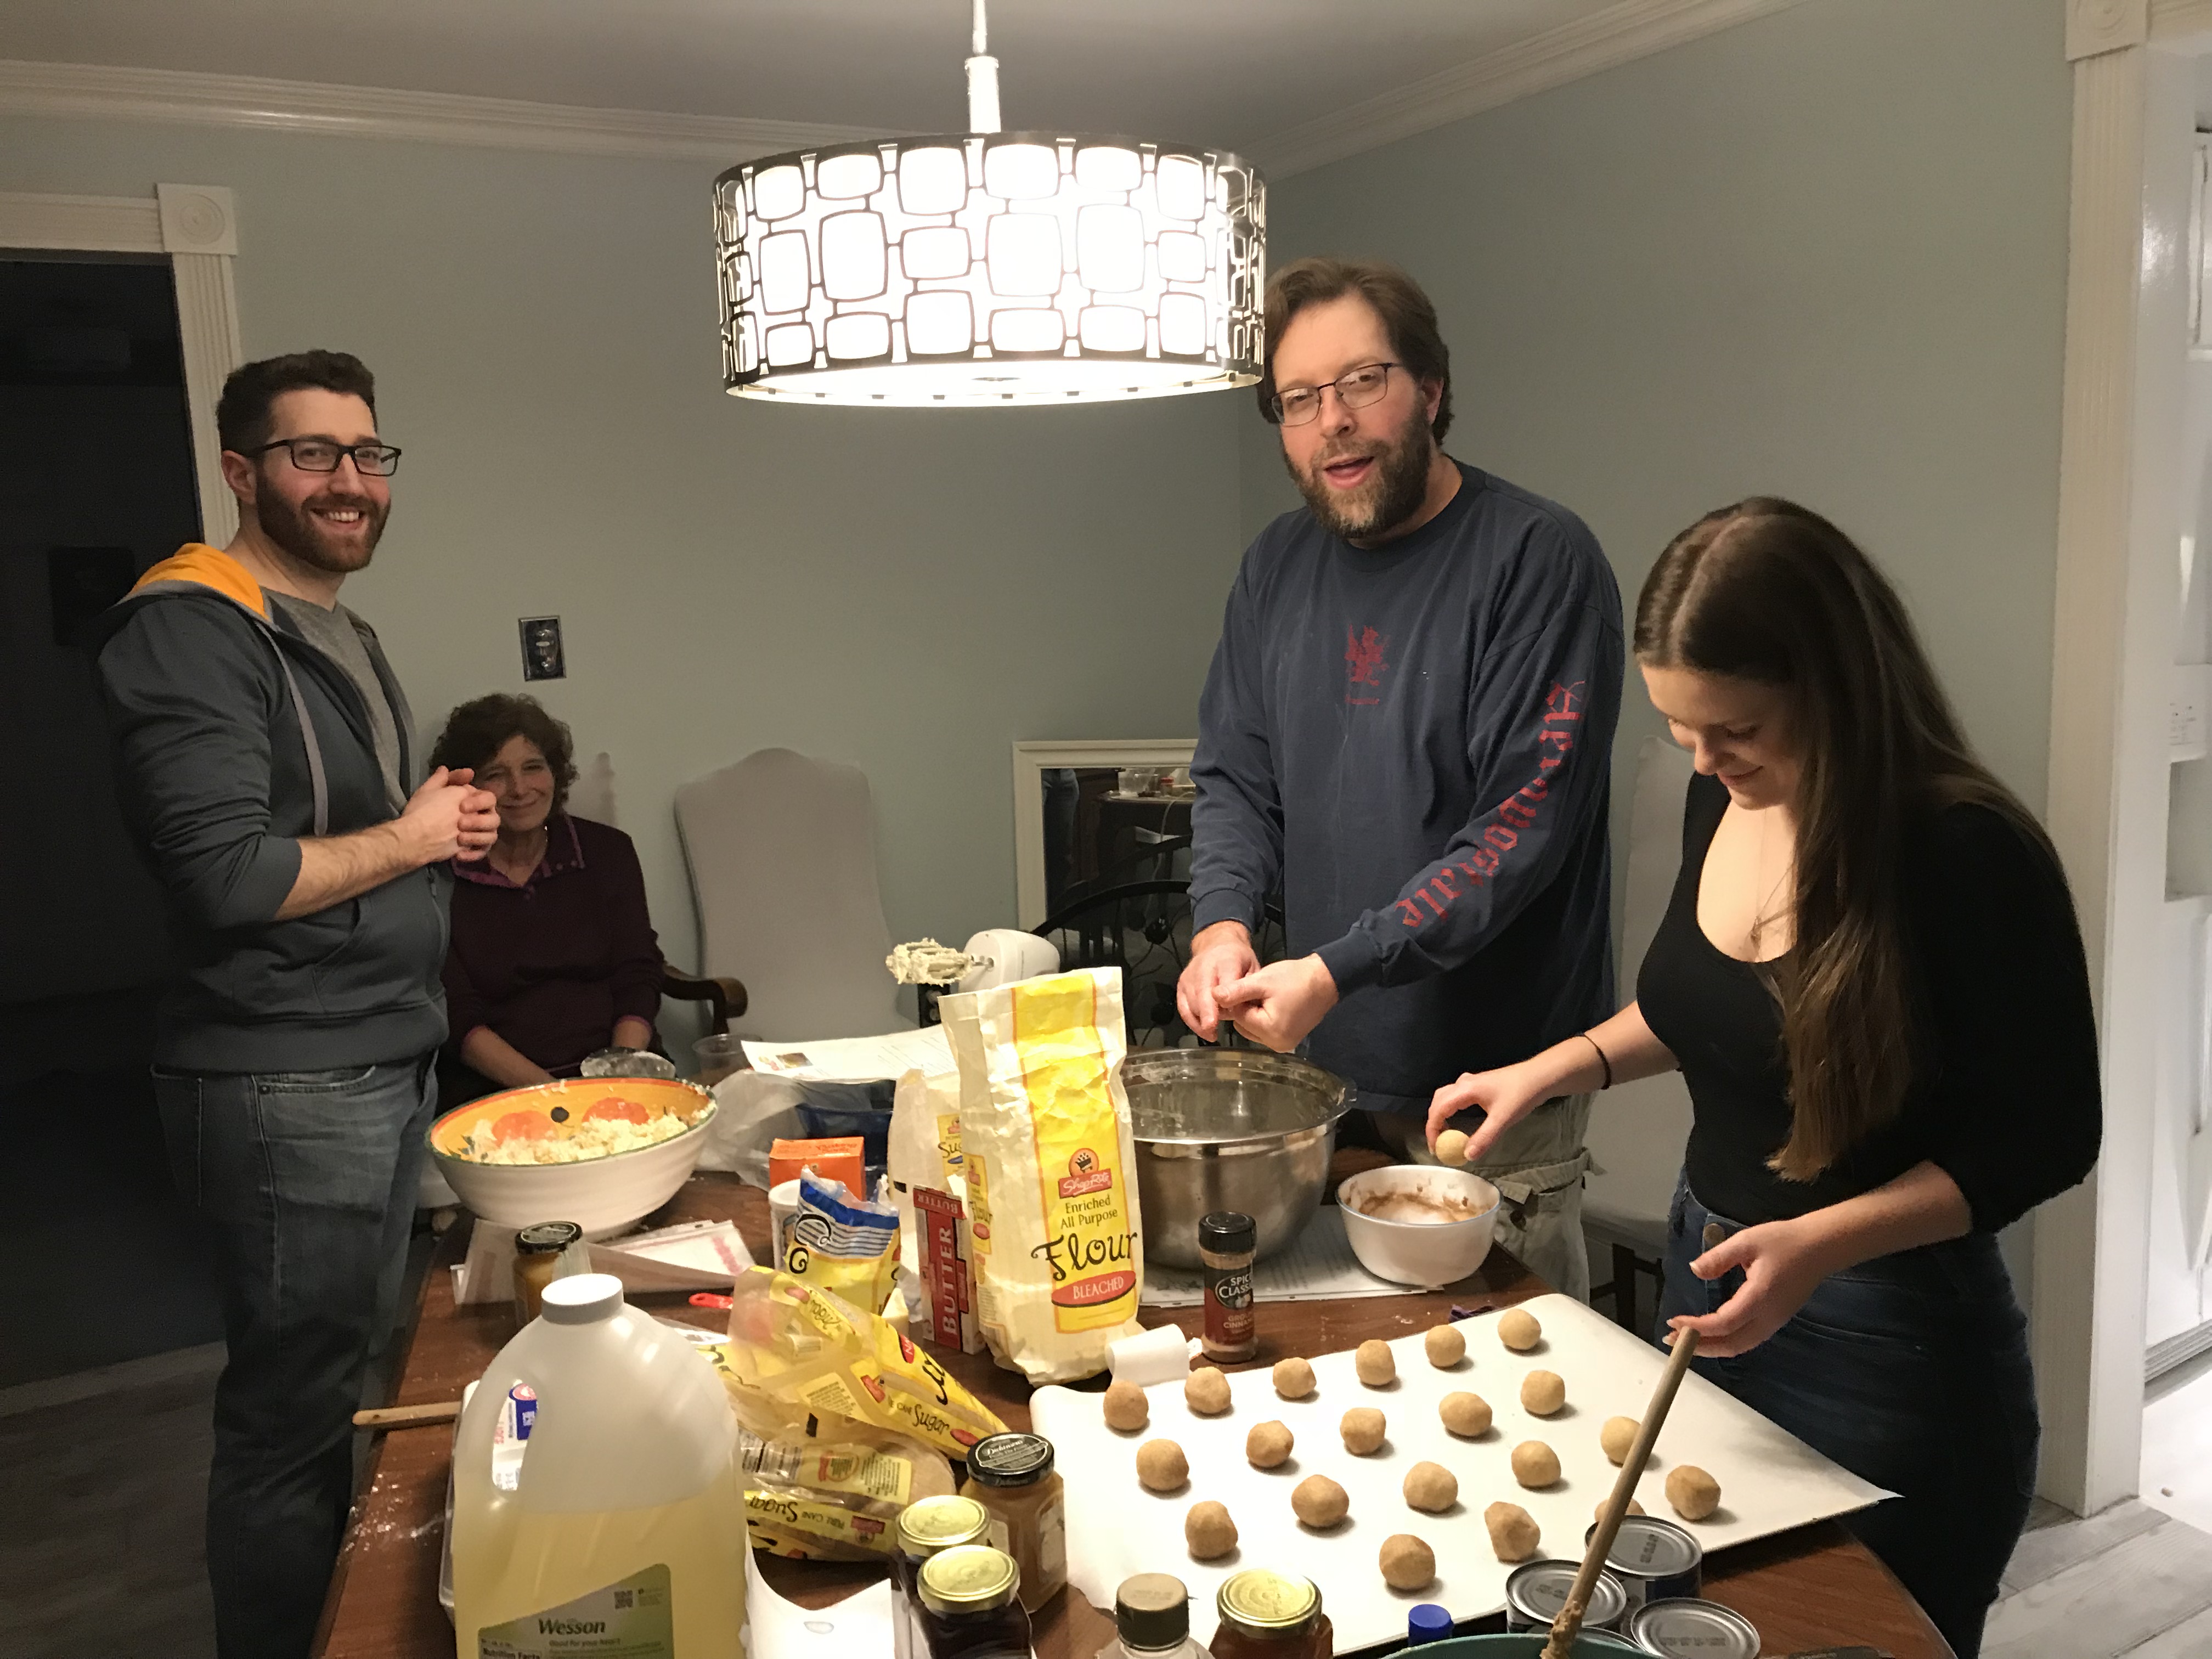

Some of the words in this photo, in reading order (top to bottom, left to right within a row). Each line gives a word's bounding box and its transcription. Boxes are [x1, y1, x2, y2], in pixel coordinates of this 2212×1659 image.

[1063, 1172, 1111, 1195] ShopRite
[918, 1194, 958, 1215] BUTTER
[1065, 1195, 1111, 1214] Enriched
[1060, 1214, 1074, 1229] All
[1079, 1208, 1118, 1227] Purpose
[1031, 1232, 1138, 1282] Flour
[939, 1227, 958, 1336] BUTTER
[1073, 1276, 1124, 1300] BLEACHED
[912, 1404, 950, 1435] Sugar
[538, 1617, 606, 1635] Wesson
